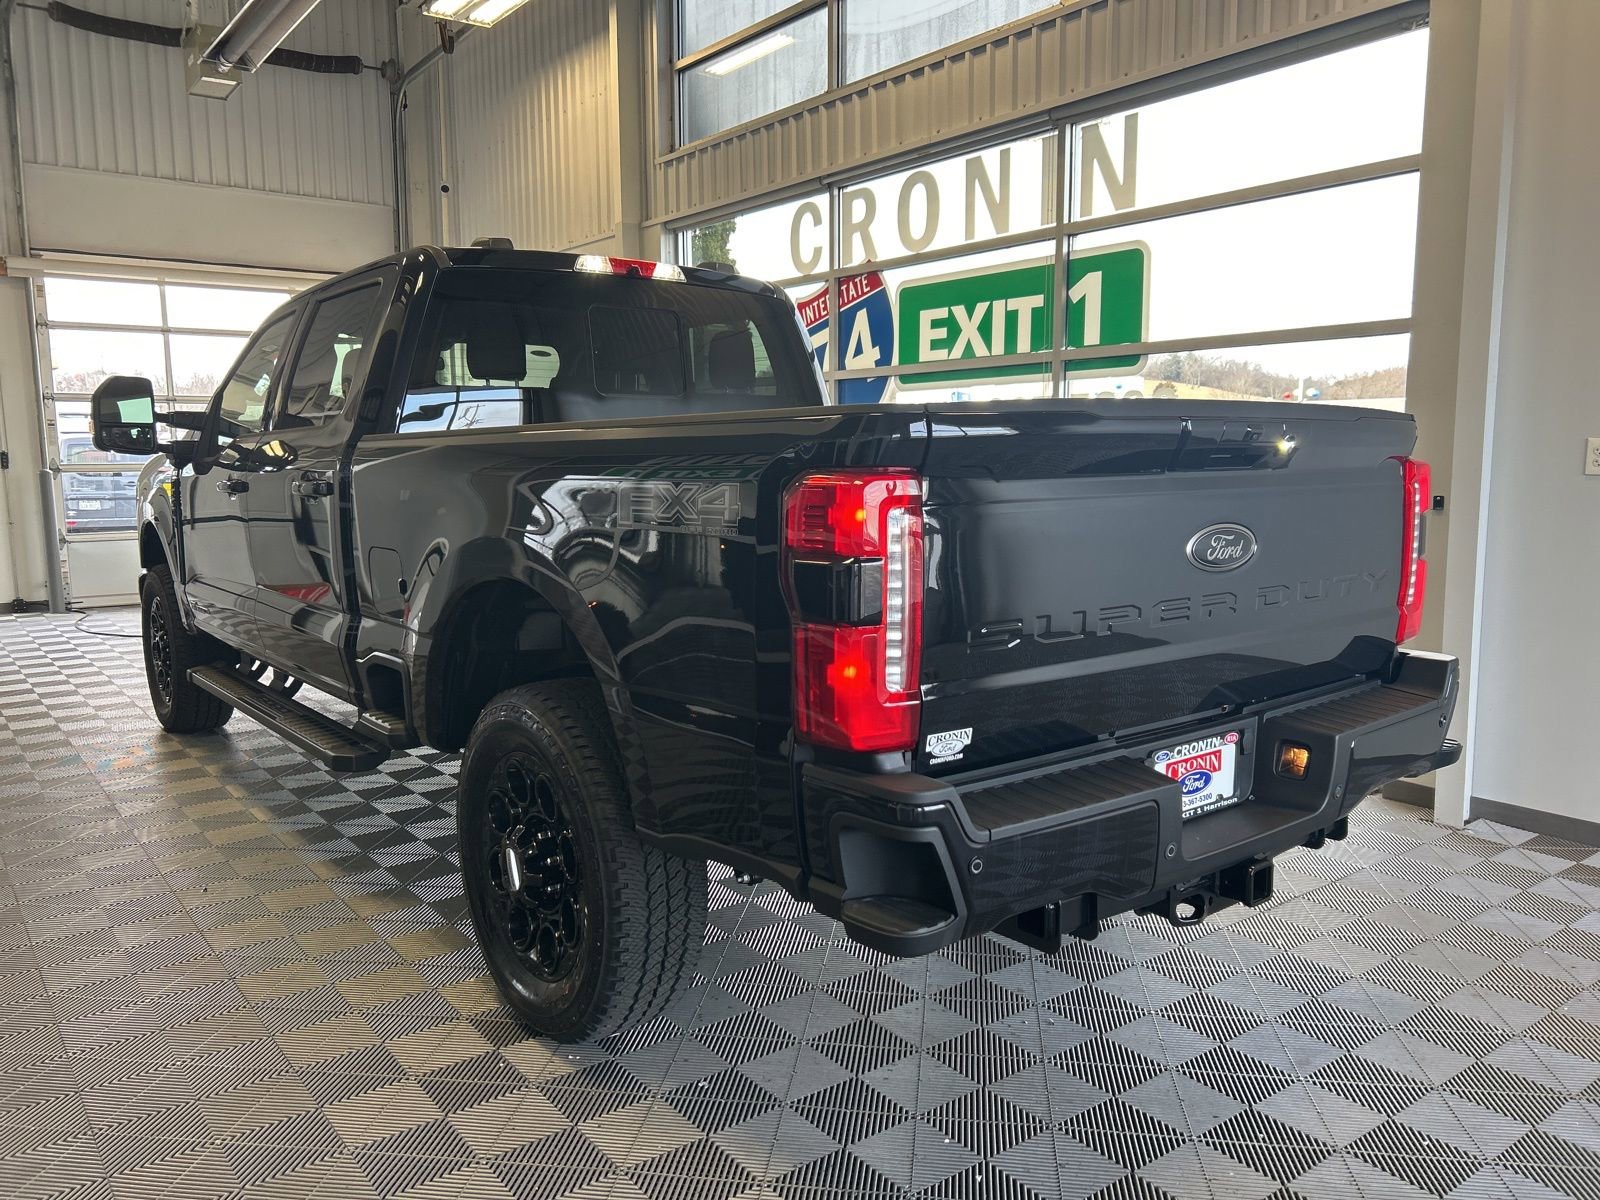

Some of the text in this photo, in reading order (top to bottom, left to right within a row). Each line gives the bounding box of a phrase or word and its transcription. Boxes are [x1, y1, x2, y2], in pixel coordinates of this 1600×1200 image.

[790, 112, 1140, 275] CRONIN
[802, 274, 871, 326] INTETATE
[919, 271, 1103, 362] EXIT 1
[617, 481, 741, 528] FX4
[1207, 534, 1244, 561] Ford
[966, 567, 1390, 654] SUPER DUTY
[928, 729, 971, 747] CRONIN
[938, 742, 958, 754] Ford
[1174, 737, 1221, 758] CRONIN
[1168, 752, 1220, 779] CRONIN
[1182, 774, 1206, 793] Ford
[1182, 792, 1213, 808] 3-367-5300
[1203, 797, 1238, 812] Harrison
